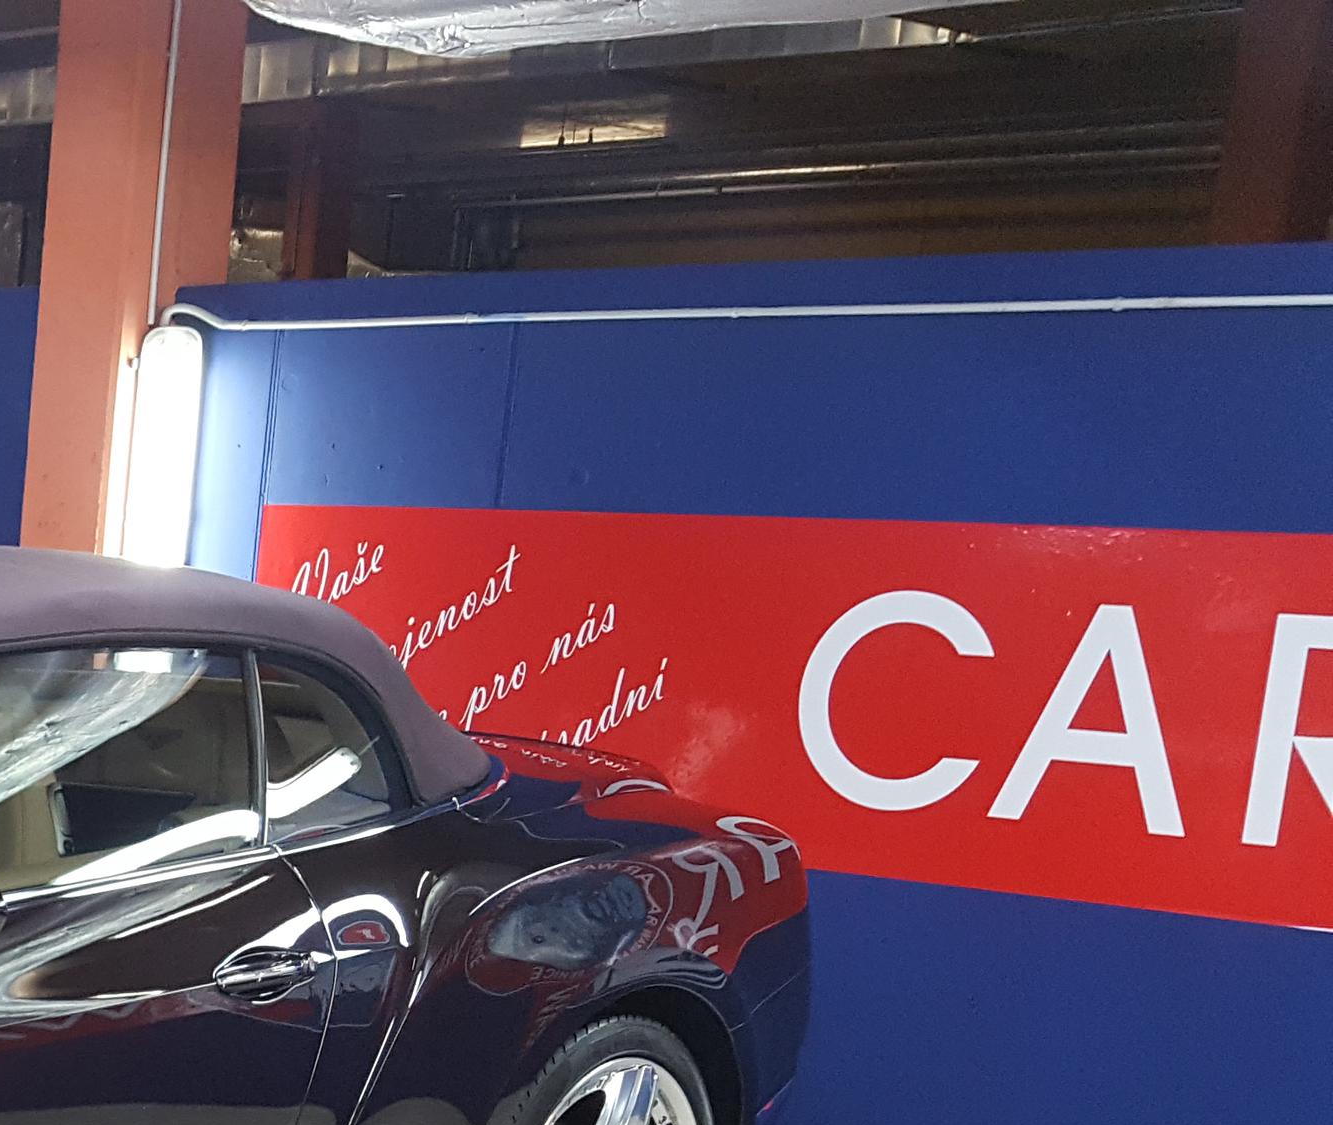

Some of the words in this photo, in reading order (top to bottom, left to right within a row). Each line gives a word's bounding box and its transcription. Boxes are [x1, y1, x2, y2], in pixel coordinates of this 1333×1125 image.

[291, 541, 385, 604] Vaše
[389, 545, 521, 671] jenost
[459, 661, 526, 731] pro
[540, 603, 615, 674] nás
